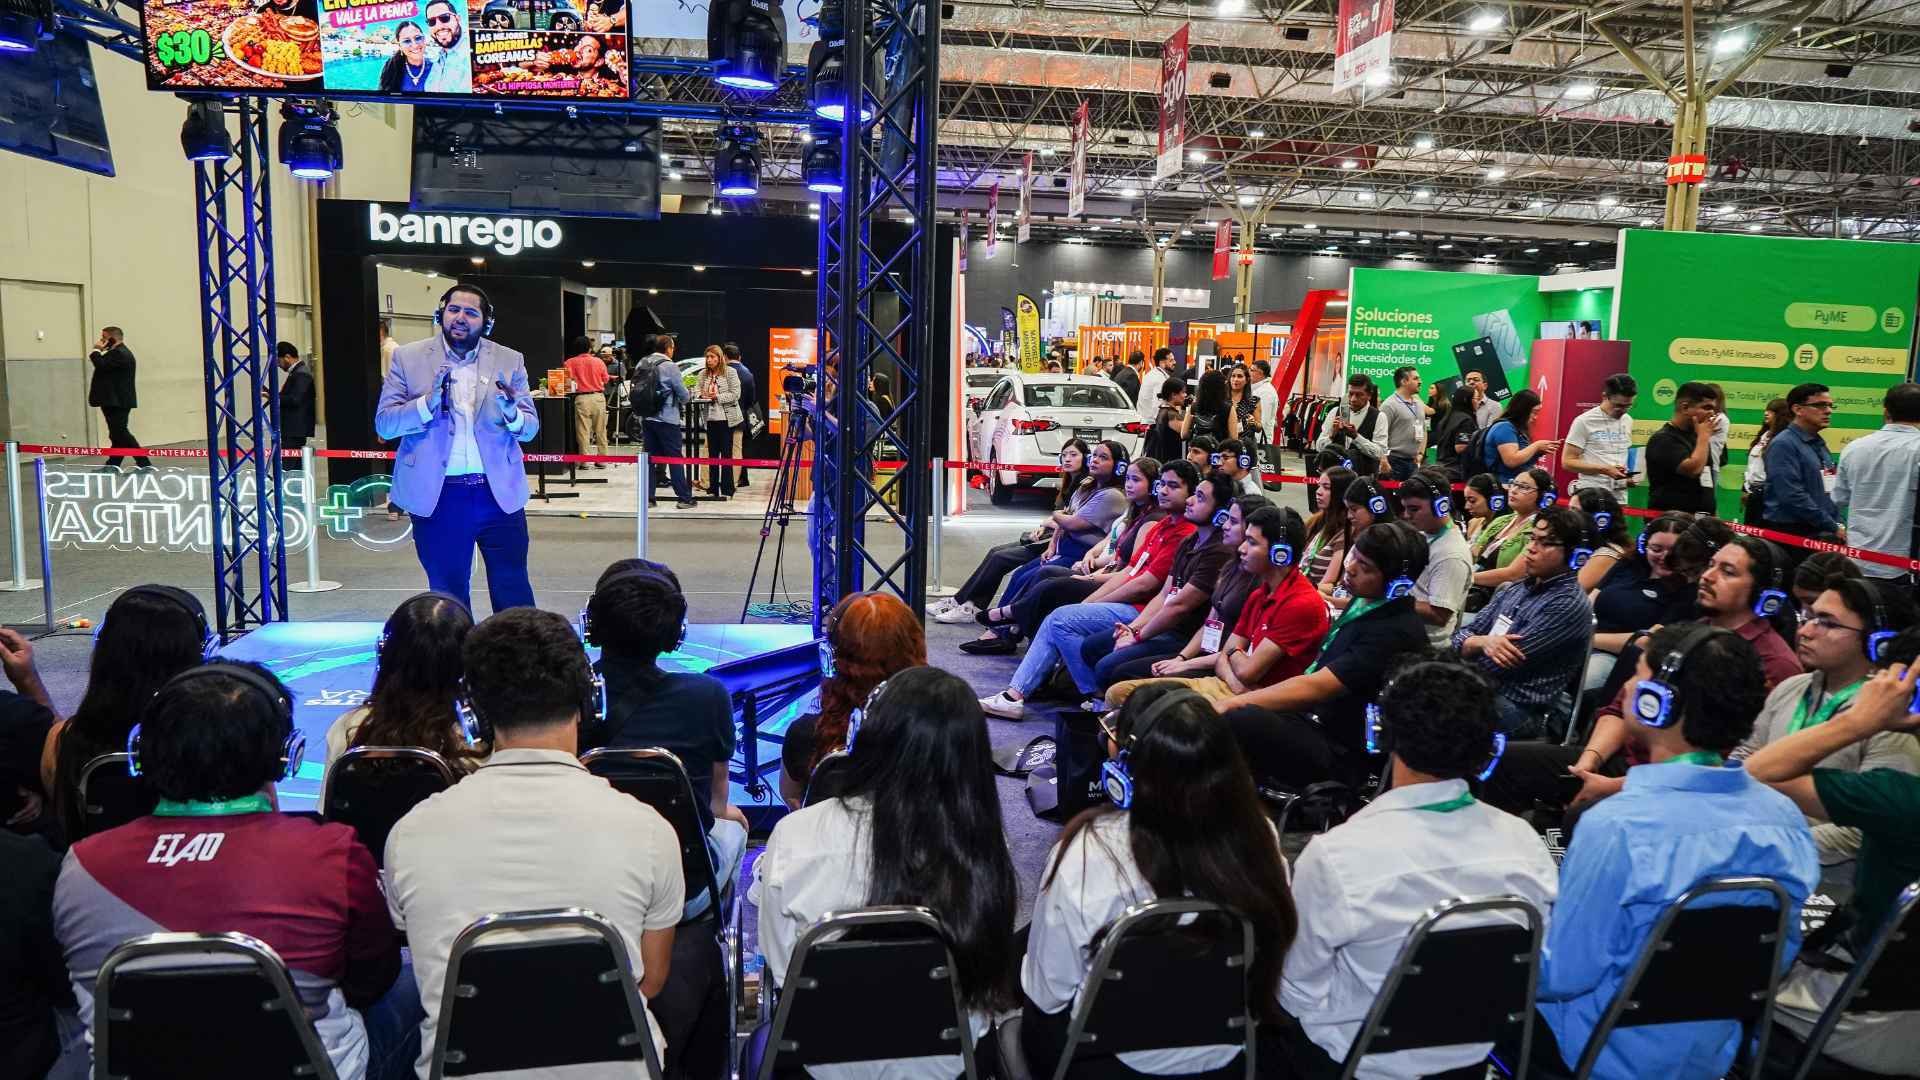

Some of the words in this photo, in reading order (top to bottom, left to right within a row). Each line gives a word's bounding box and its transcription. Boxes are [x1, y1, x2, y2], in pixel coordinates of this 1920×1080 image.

[336, 9, 363, 25] VALE
[365, 6, 378, 21] LA
[475, 33, 492, 42] LAS
[493, 32, 528, 41] MEJORES
[157, 30, 211, 67] $30
[476, 38, 543, 54] BANDERILLAS
[477, 50, 535, 64] COREANAS
[370, 203, 562, 256] banregio
[1356, 306, 1432, 324] Soluciones
[1814, 310, 1848, 324] PyME
[1354, 322, 1440, 339] Financieras
[1352, 338, 1390, 350] hechas
[1392, 342, 1417, 352] para
[1420, 342, 1434, 352] las
[1352, 353, 1416, 364] necesidades
[1418, 355, 1432, 364] de
[1350, 365, 1361, 374] tu
[1364, 367, 1396, 378] negoc
[42, 447, 102, 455] CINTERMEX
[148, 450, 208, 458] CINTERMEX
[527, 454, 564, 462] CINTERMEX
[1803, 538, 1862, 558] CINTERMEX
